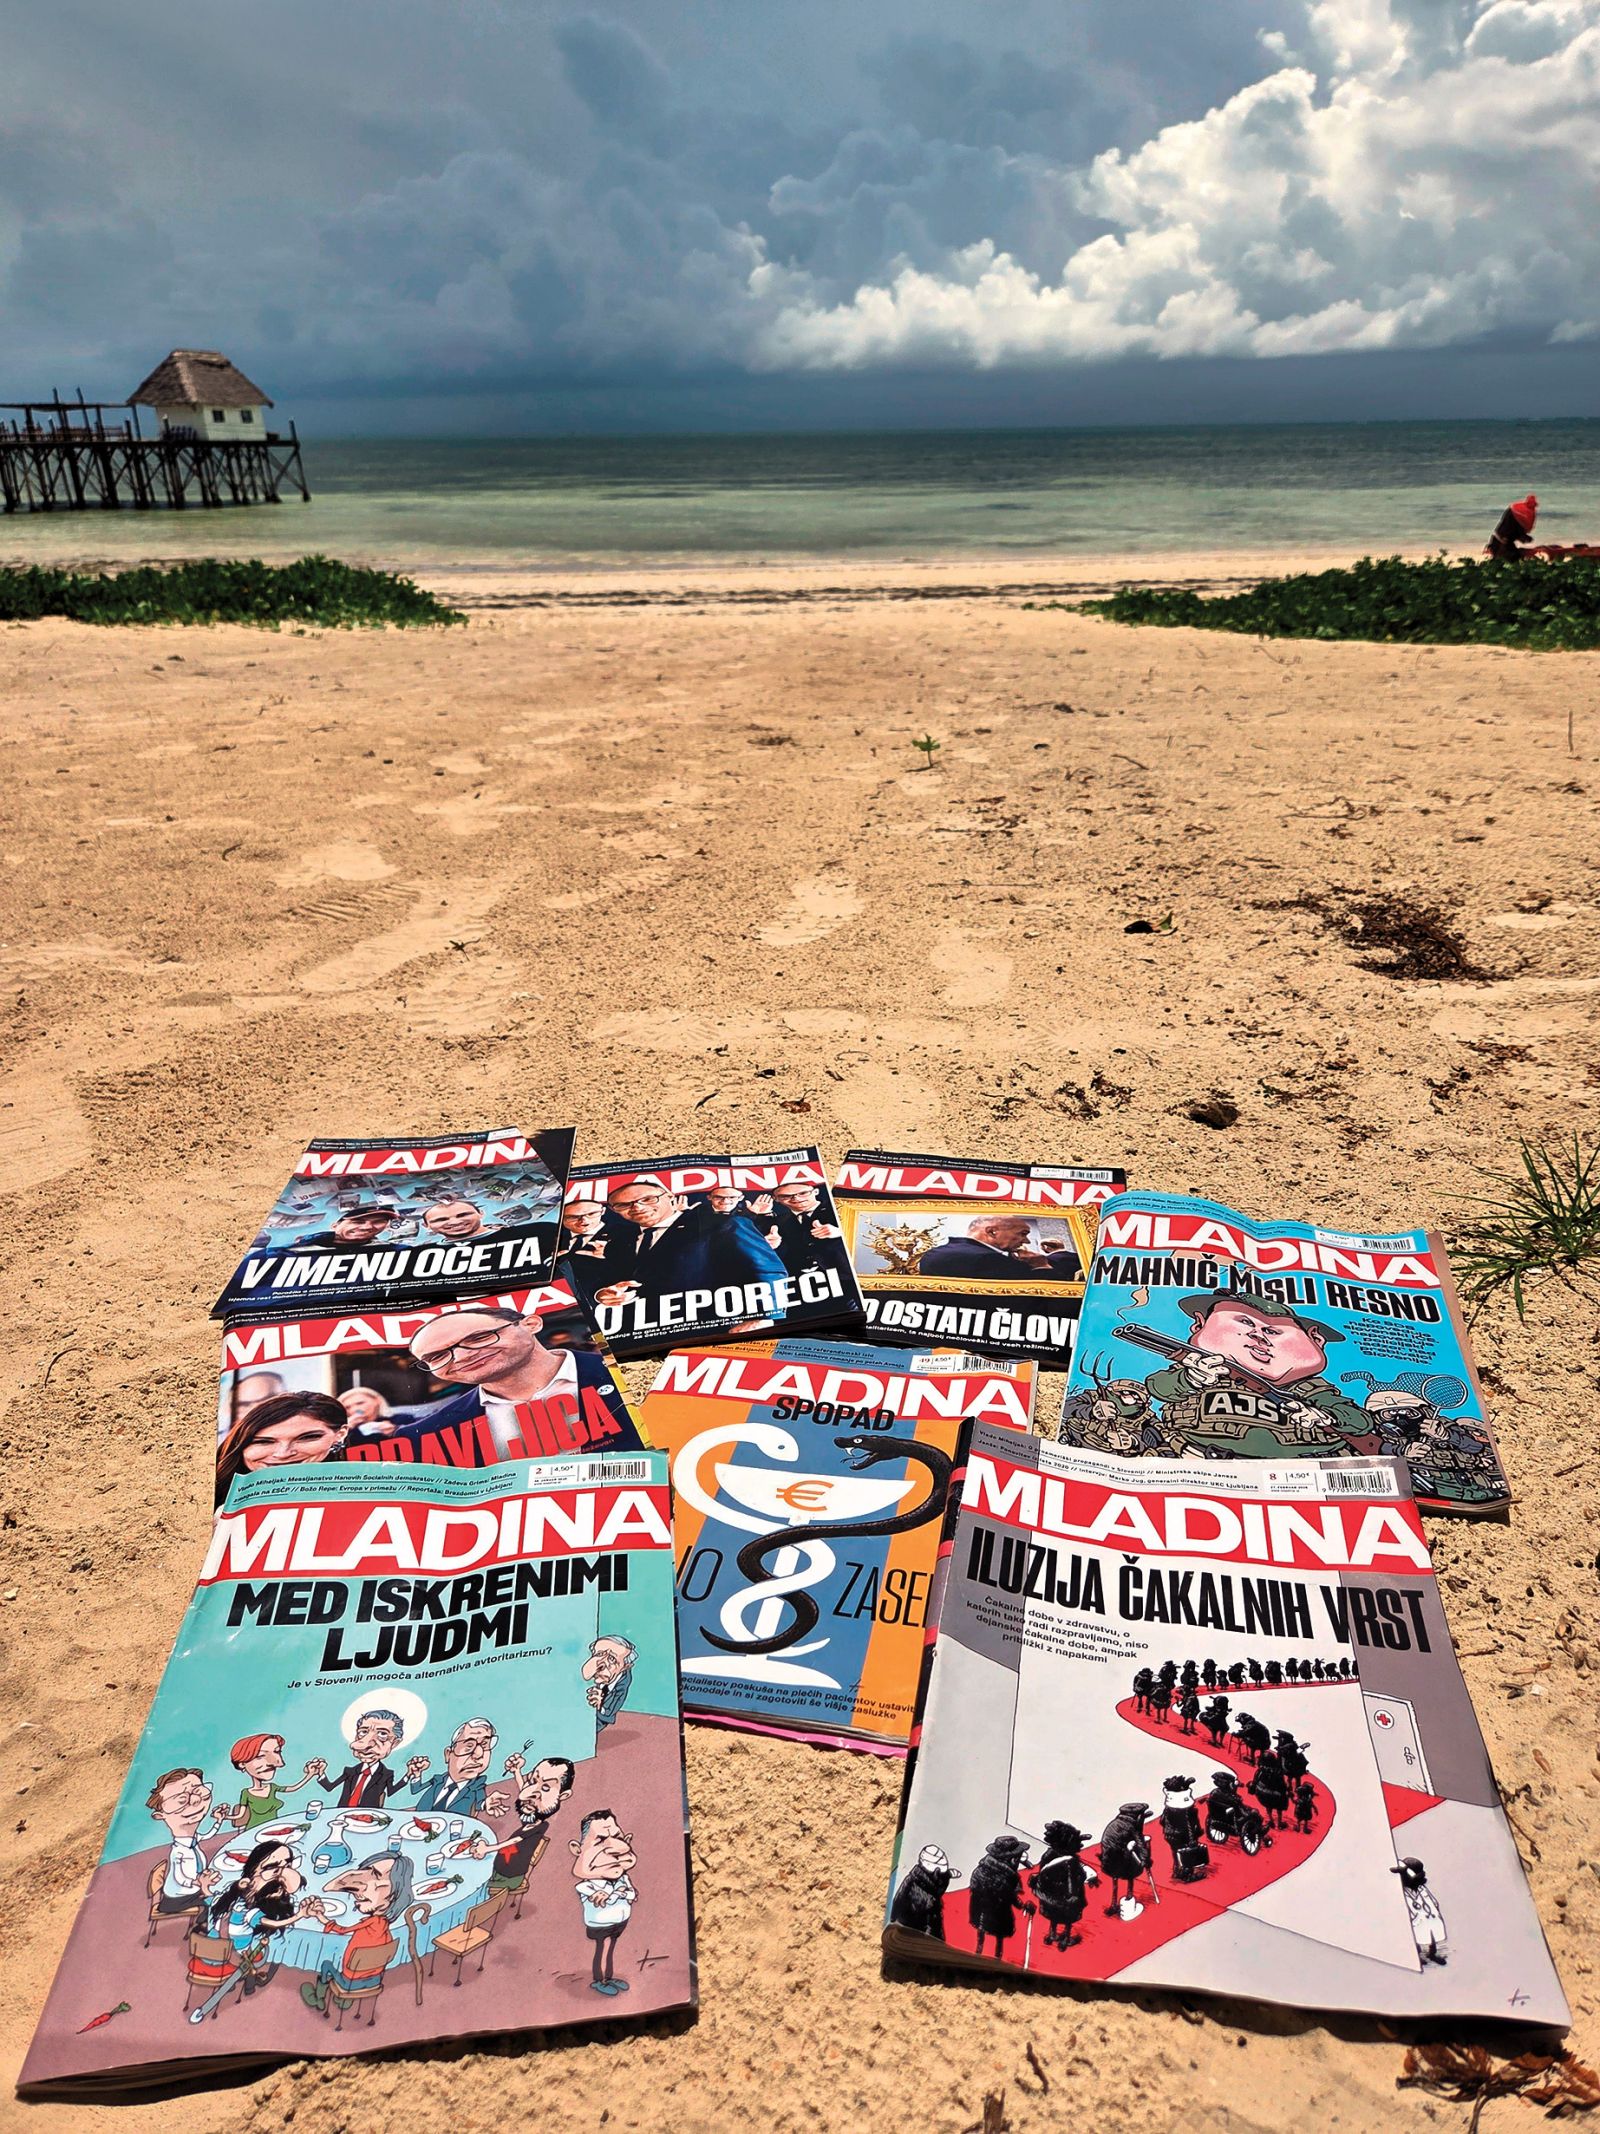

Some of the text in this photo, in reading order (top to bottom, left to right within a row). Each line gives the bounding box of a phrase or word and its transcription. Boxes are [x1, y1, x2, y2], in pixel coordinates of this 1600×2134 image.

[294, 1138, 538, 1175] MLADIN
[834, 1163, 1117, 1205] MLADINA
[241, 1257, 278, 1289] V
[271, 1250, 411, 1289] IMENU
[412, 1236, 542, 1278] OČETA
[1097, 1213, 1441, 1287] MLADINA
[634, 1265, 845, 1329] LEPOREČI
[1093, 1253, 1442, 1323] MAHNIČ MISLI RESNO
[222, 1284, 577, 1367] MLADA
[880, 1300, 986, 1337] OSTATI
[945, 1334, 988, 1345] nečloveški
[650, 1355, 1029, 1426] MLADINA
[1208, 1392, 1279, 1426] AJS
[346, 1384, 623, 1467] AVLJICA
[771, 1396, 896, 1431] SPOPAD
[339, 1485, 363, 1493] Evropa
[369, 1484, 397, 1493] primežu
[406, 1485, 444, 1494] Reportaža:
[362, 1473, 394, 1481] Socialnih
[394, 1474, 435, 1483] demokratov
[443, 1478, 468, 1486] Zadeva
[490, 1471, 517, 1482] Mladina
[535, 1467, 542, 1475] 2
[1180, 1477, 1209, 1486] direktor
[1289, 1472, 1310, 1480] 4,50€
[960, 1452, 1434, 1569] MLADINA
[199, 1490, 672, 1581] MLADINA
[226, 1553, 629, 1627] MED ISKRENIMI
[966, 1527, 1433, 1653] ILUZIJA ČAKALNIH VRST
[319, 1604, 529, 1672] LJUDMI
[966, 1600, 1149, 1650] katerih tako radi razpravljamo, niso
[975, 1614, 1138, 1659] dejanske čakalne dobe, ampak
[984, 1595, 1026, 1614] Čakalne
[1028, 1609, 1055, 1623] dobe
[1065, 1617, 1121, 1638] zdravstvu,
[287, 1679, 302, 1689] Je
[314, 1673, 364, 1687] Sloveniji
[365, 1671, 412, 1682] mogoča
[414, 1661, 472, 1680] alternativa
[473, 1646, 553, 1668] avtoritarizmu?
[1002, 1632, 1044, 1650] približki
[1055, 1647, 1108, 1664] napakami
[680, 1683, 897, 1720] konodaje in si zagotoviti še višje zaslužke
[681, 1675, 916, 1714] ecialistov poskuša na plečih pacientov ustavit
